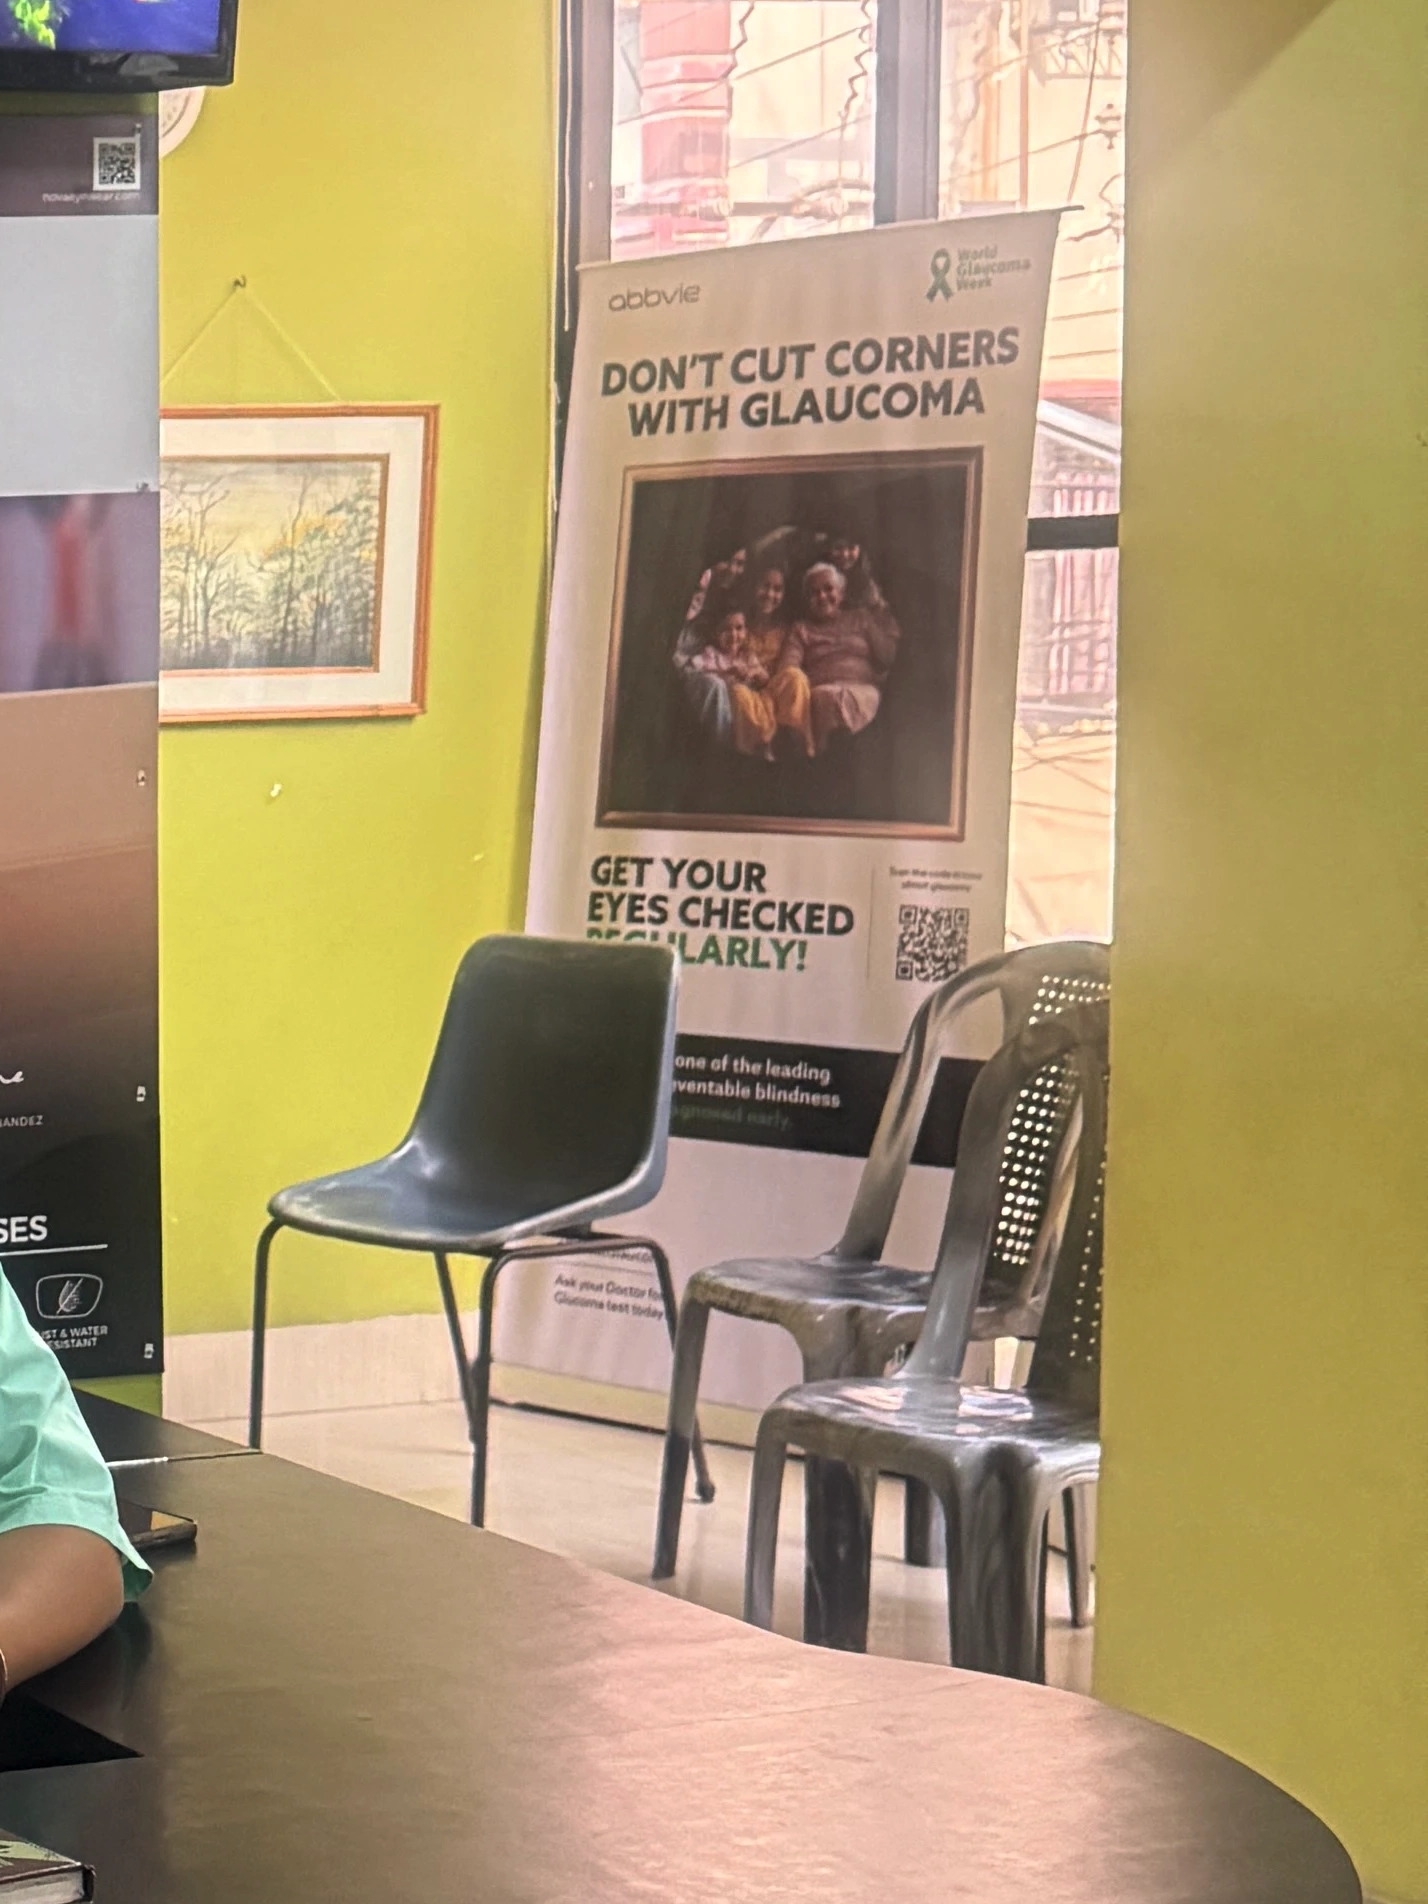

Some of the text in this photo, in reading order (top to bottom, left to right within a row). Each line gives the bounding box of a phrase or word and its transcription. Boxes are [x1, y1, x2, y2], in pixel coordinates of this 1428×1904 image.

[608, 283, 702, 312] abbvie
[600, 325, 1022, 398] DON'T CUT CORNERS
[627, 376, 986, 438] WITH GLAUCOMA
[590, 855, 767, 894] GET YOUR
[587, 891, 855, 937] EYES CHECKED
[674, 1053, 832, 1087] one of the leading
[755, 1081, 841, 1109] blindness
[47, 1336, 98, 1350] ESISTANT
[69, 1324, 109, 1338] WATER
